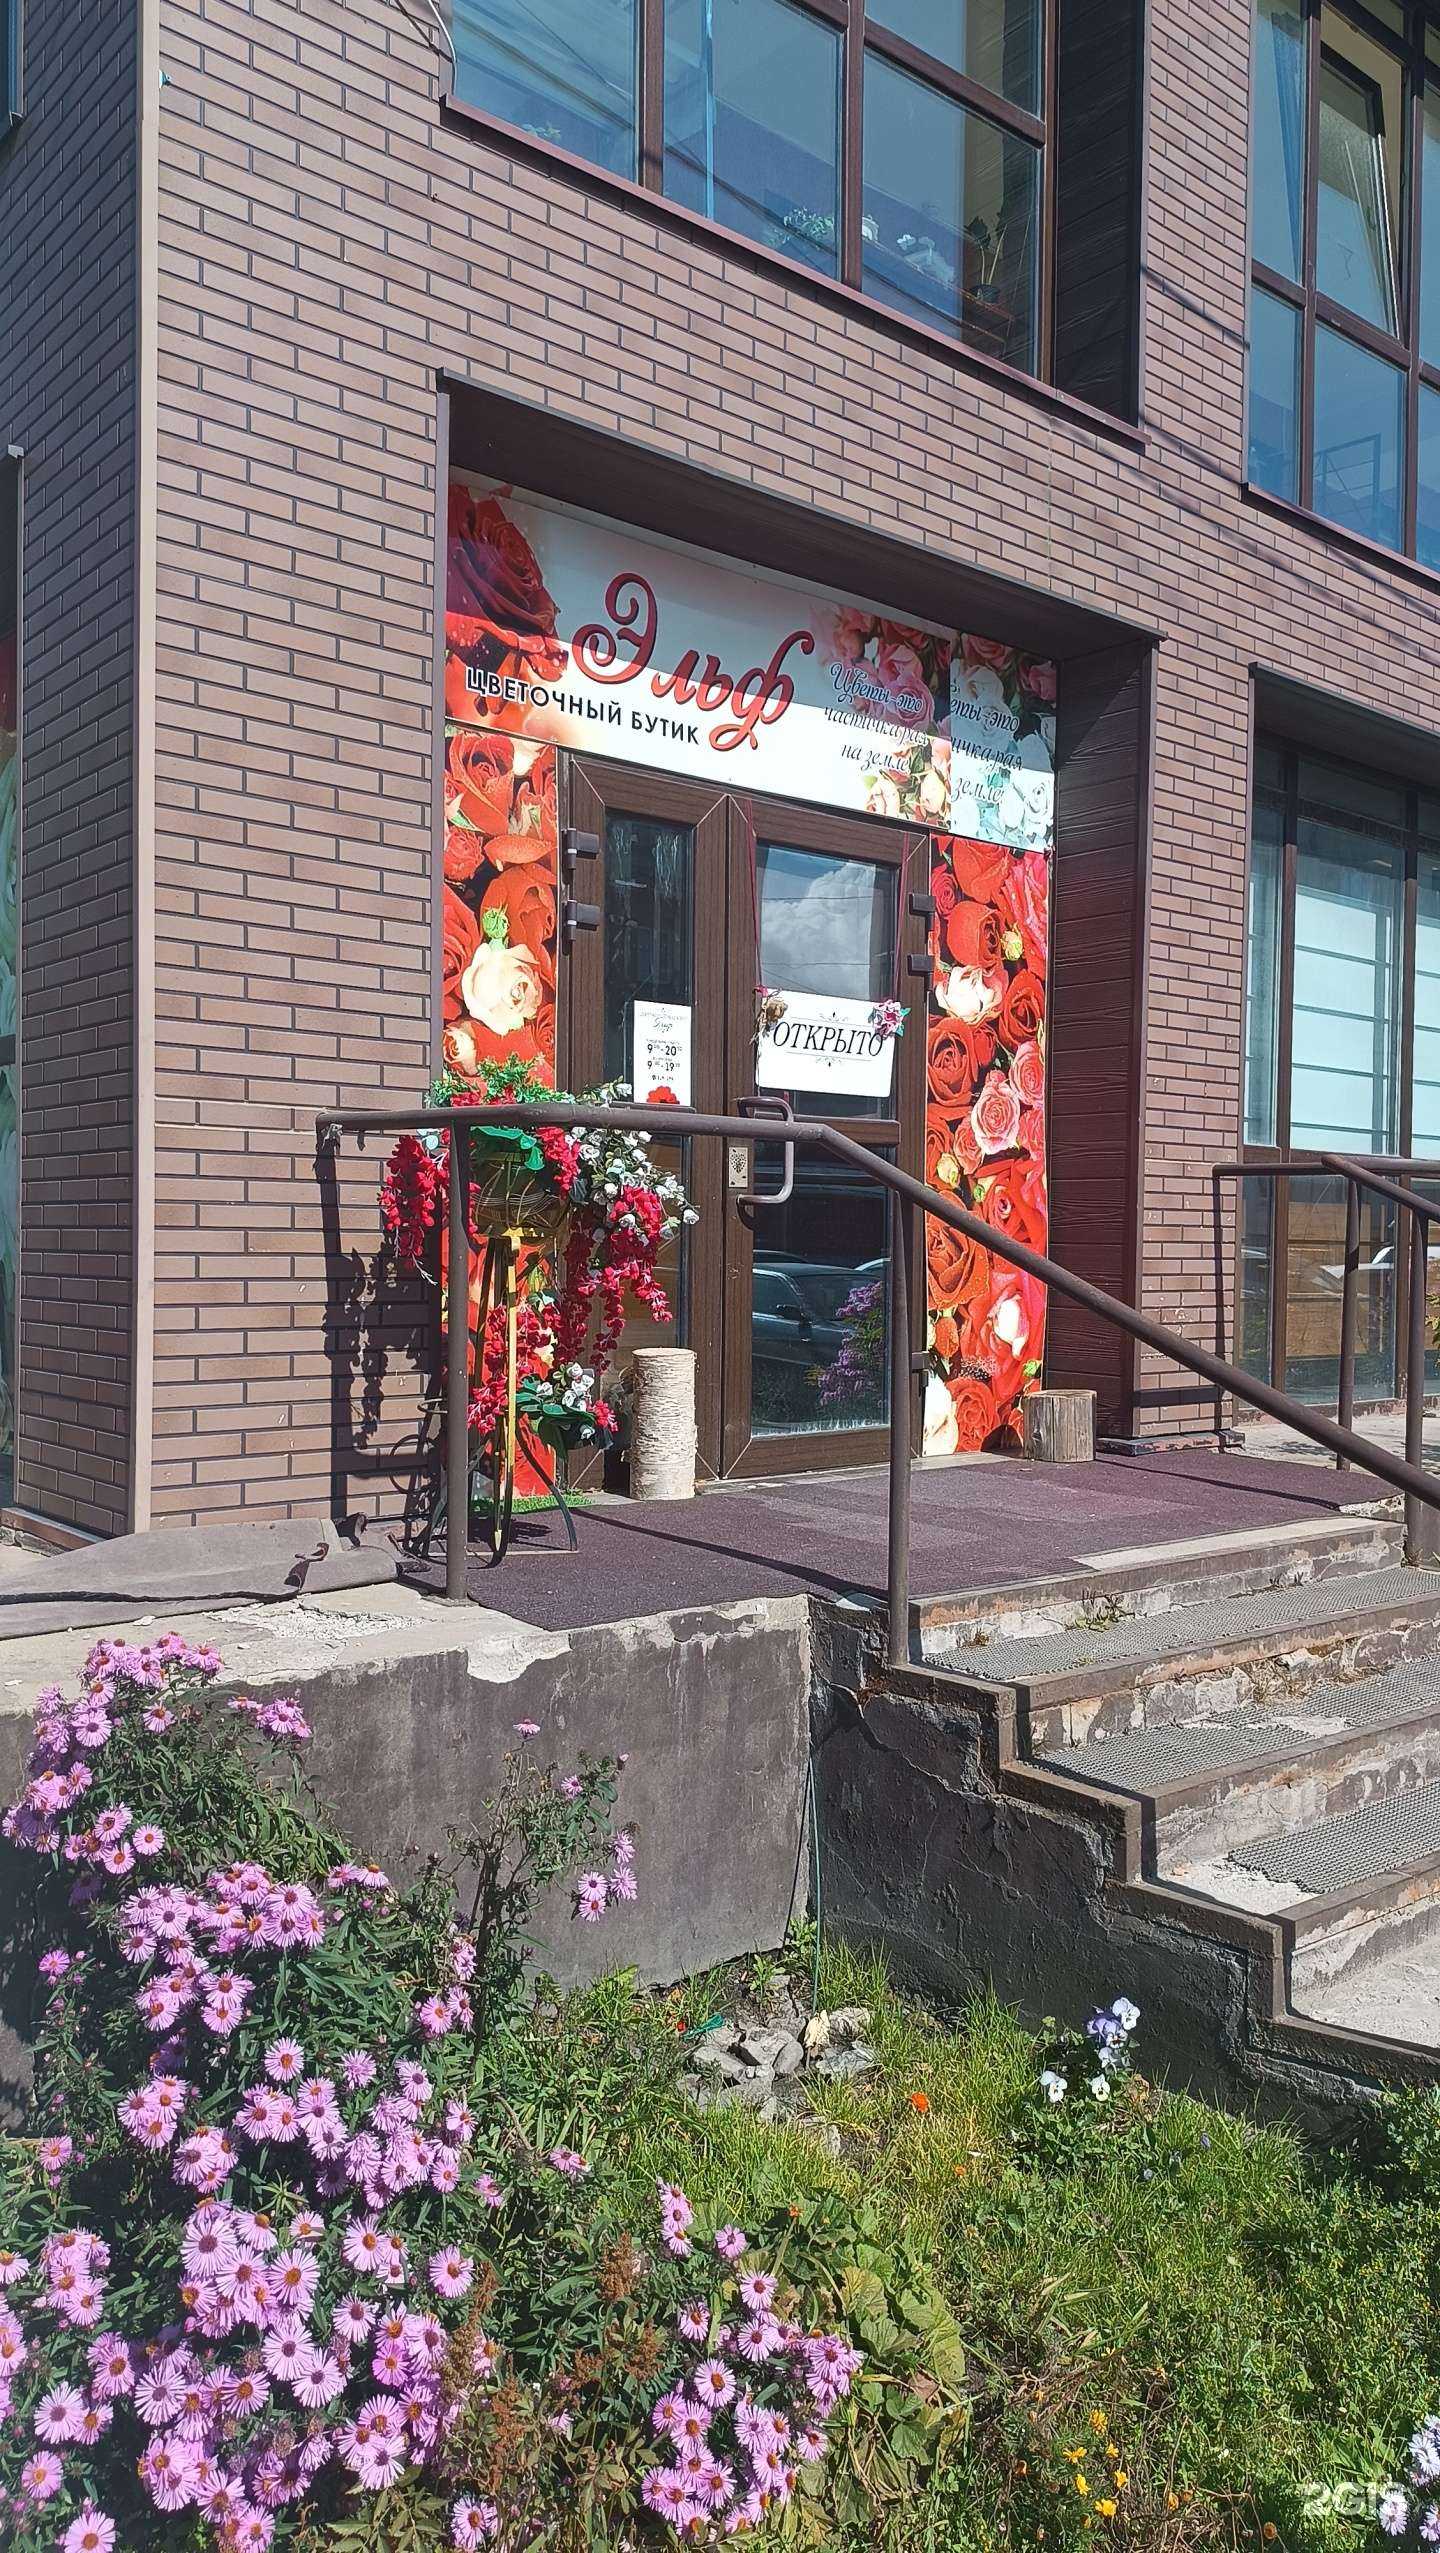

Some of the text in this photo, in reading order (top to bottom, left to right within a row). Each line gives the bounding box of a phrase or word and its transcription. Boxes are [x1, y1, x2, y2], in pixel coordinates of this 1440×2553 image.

[571, 572, 815, 752] Эльф
[466, 666, 700, 745] ЦВЕТОЧНЫЙ БУТИК
[824, 706, 928, 746] частичка рая
[841, 744, 861, 760] на
[989, 750, 1022, 773] рая
[772, 1021, 884, 1057] ОТКРЫТО
